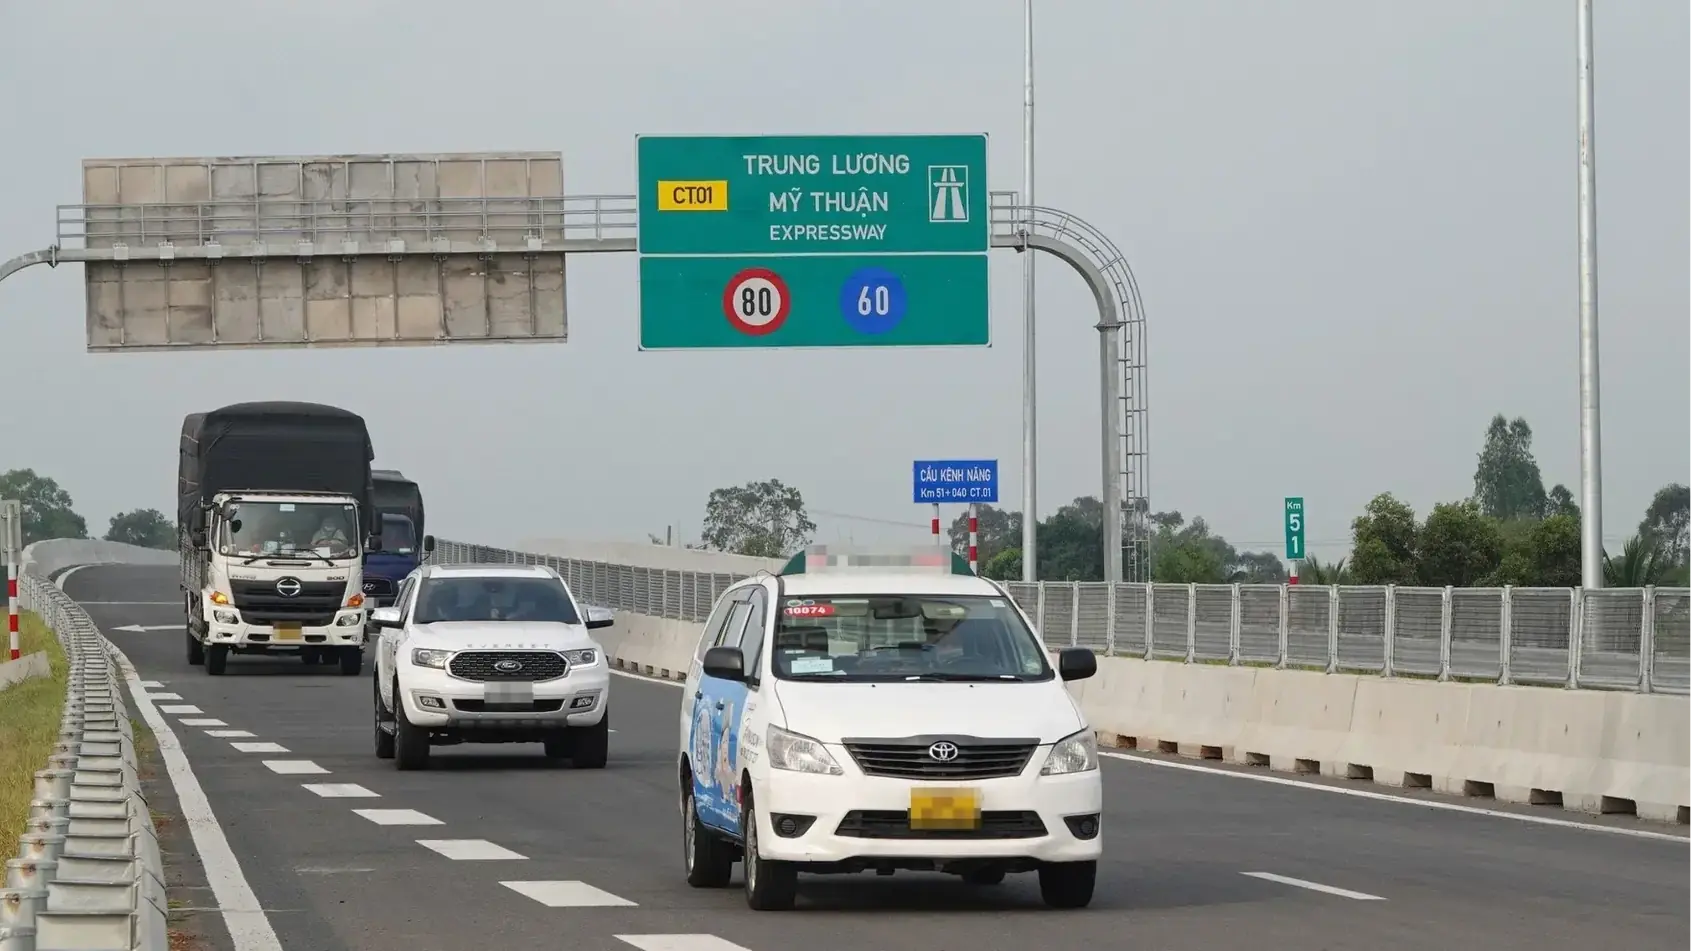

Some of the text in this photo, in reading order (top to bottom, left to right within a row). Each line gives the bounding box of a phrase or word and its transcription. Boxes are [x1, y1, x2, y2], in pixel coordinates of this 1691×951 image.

[743, 152, 910, 175] TRUNG LƯƠNG
[673, 186, 713, 205] CT.01
[769, 186, 888, 218] MỸ THUẬN
[769, 224, 887, 241] EXPRESSWAY
[741, 287, 772, 317] 80
[857, 286, 889, 316] 60
[940, 467, 964, 482] KÊNH
[920, 488, 935, 498] Km
[969, 487, 991, 498] CT.01
[1286, 501, 1301, 510] Km
